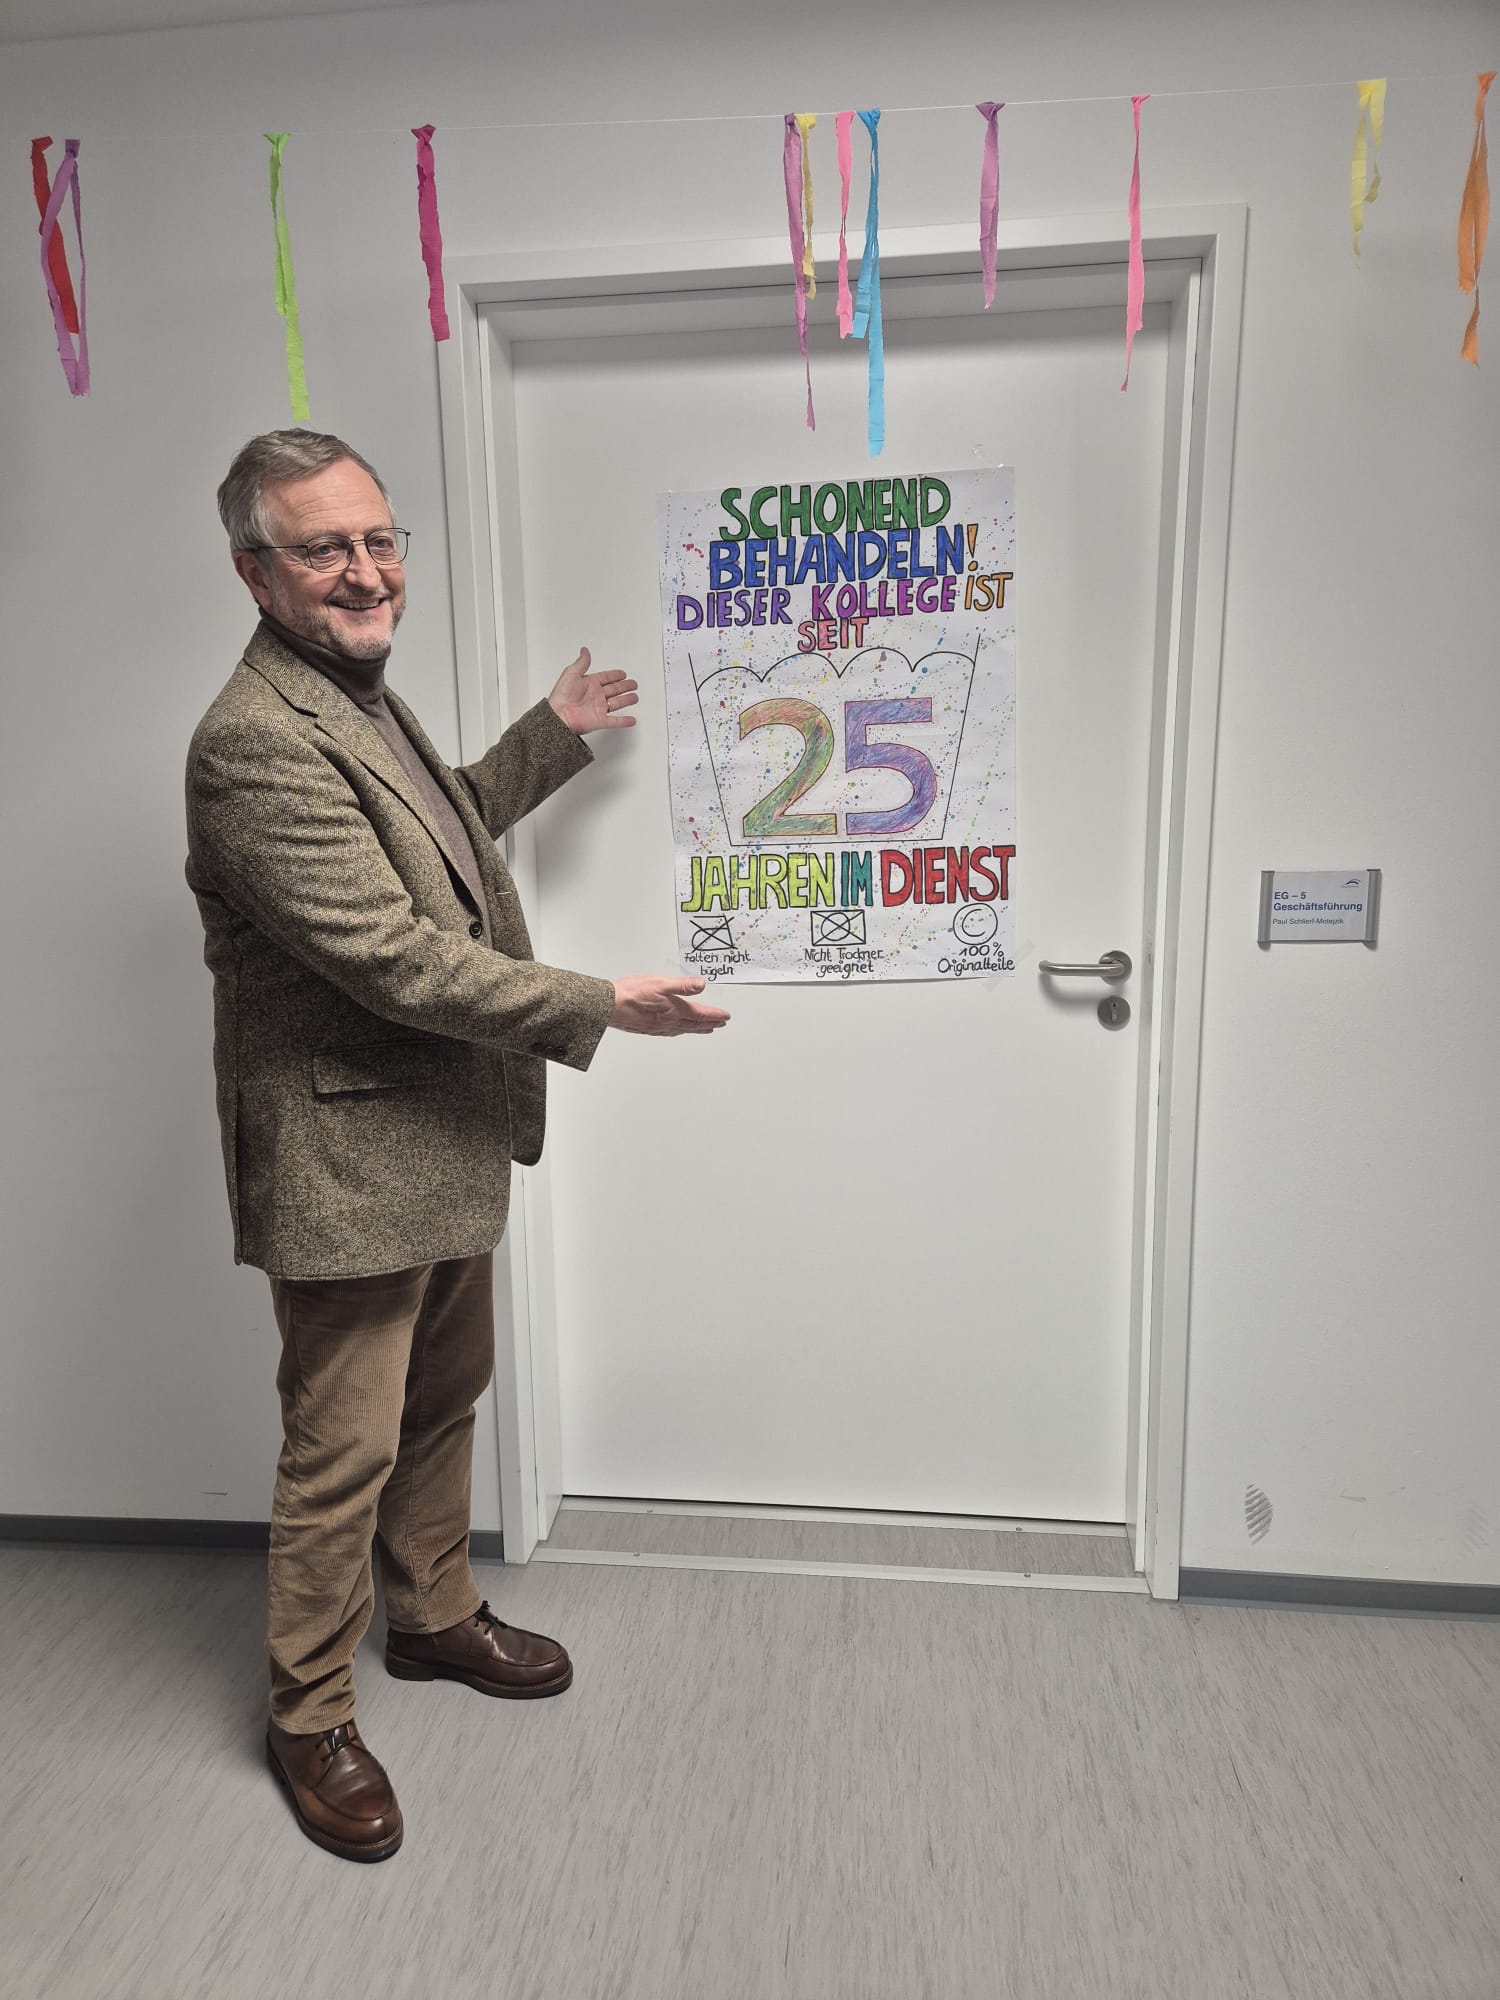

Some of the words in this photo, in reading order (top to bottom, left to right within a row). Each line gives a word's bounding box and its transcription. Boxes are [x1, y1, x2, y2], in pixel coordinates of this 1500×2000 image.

[719, 477, 951, 542] SCHONEND
[709, 523, 979, 590] BEHANDELN!
[677, 588, 793, 630] DIESER
[811, 576, 957, 622] KOLLEGE
[965, 572, 1013, 611] IST
[797, 616, 870, 652] SEIT
[738, 697, 938, 837] 25
[681, 852, 836, 912] JAHREN
[840, 851, 874, 907] IM
[880, 844, 1016, 907] DIENST
[1274, 891, 1289, 900] EG
[1300, 891, 1307, 900] 5
[1273, 902, 1363, 912] Geschäftsführung
[684, 952, 718, 963] Falten
[724, 950, 751, 964] nicht
[804, 947, 832, 962] Nicht
[836, 947, 883, 961] Trockner
[700, 964, 734, 982] bügeln
[816, 960, 874, 979] geeignet
[938, 957, 1015, 977] Originalteile
